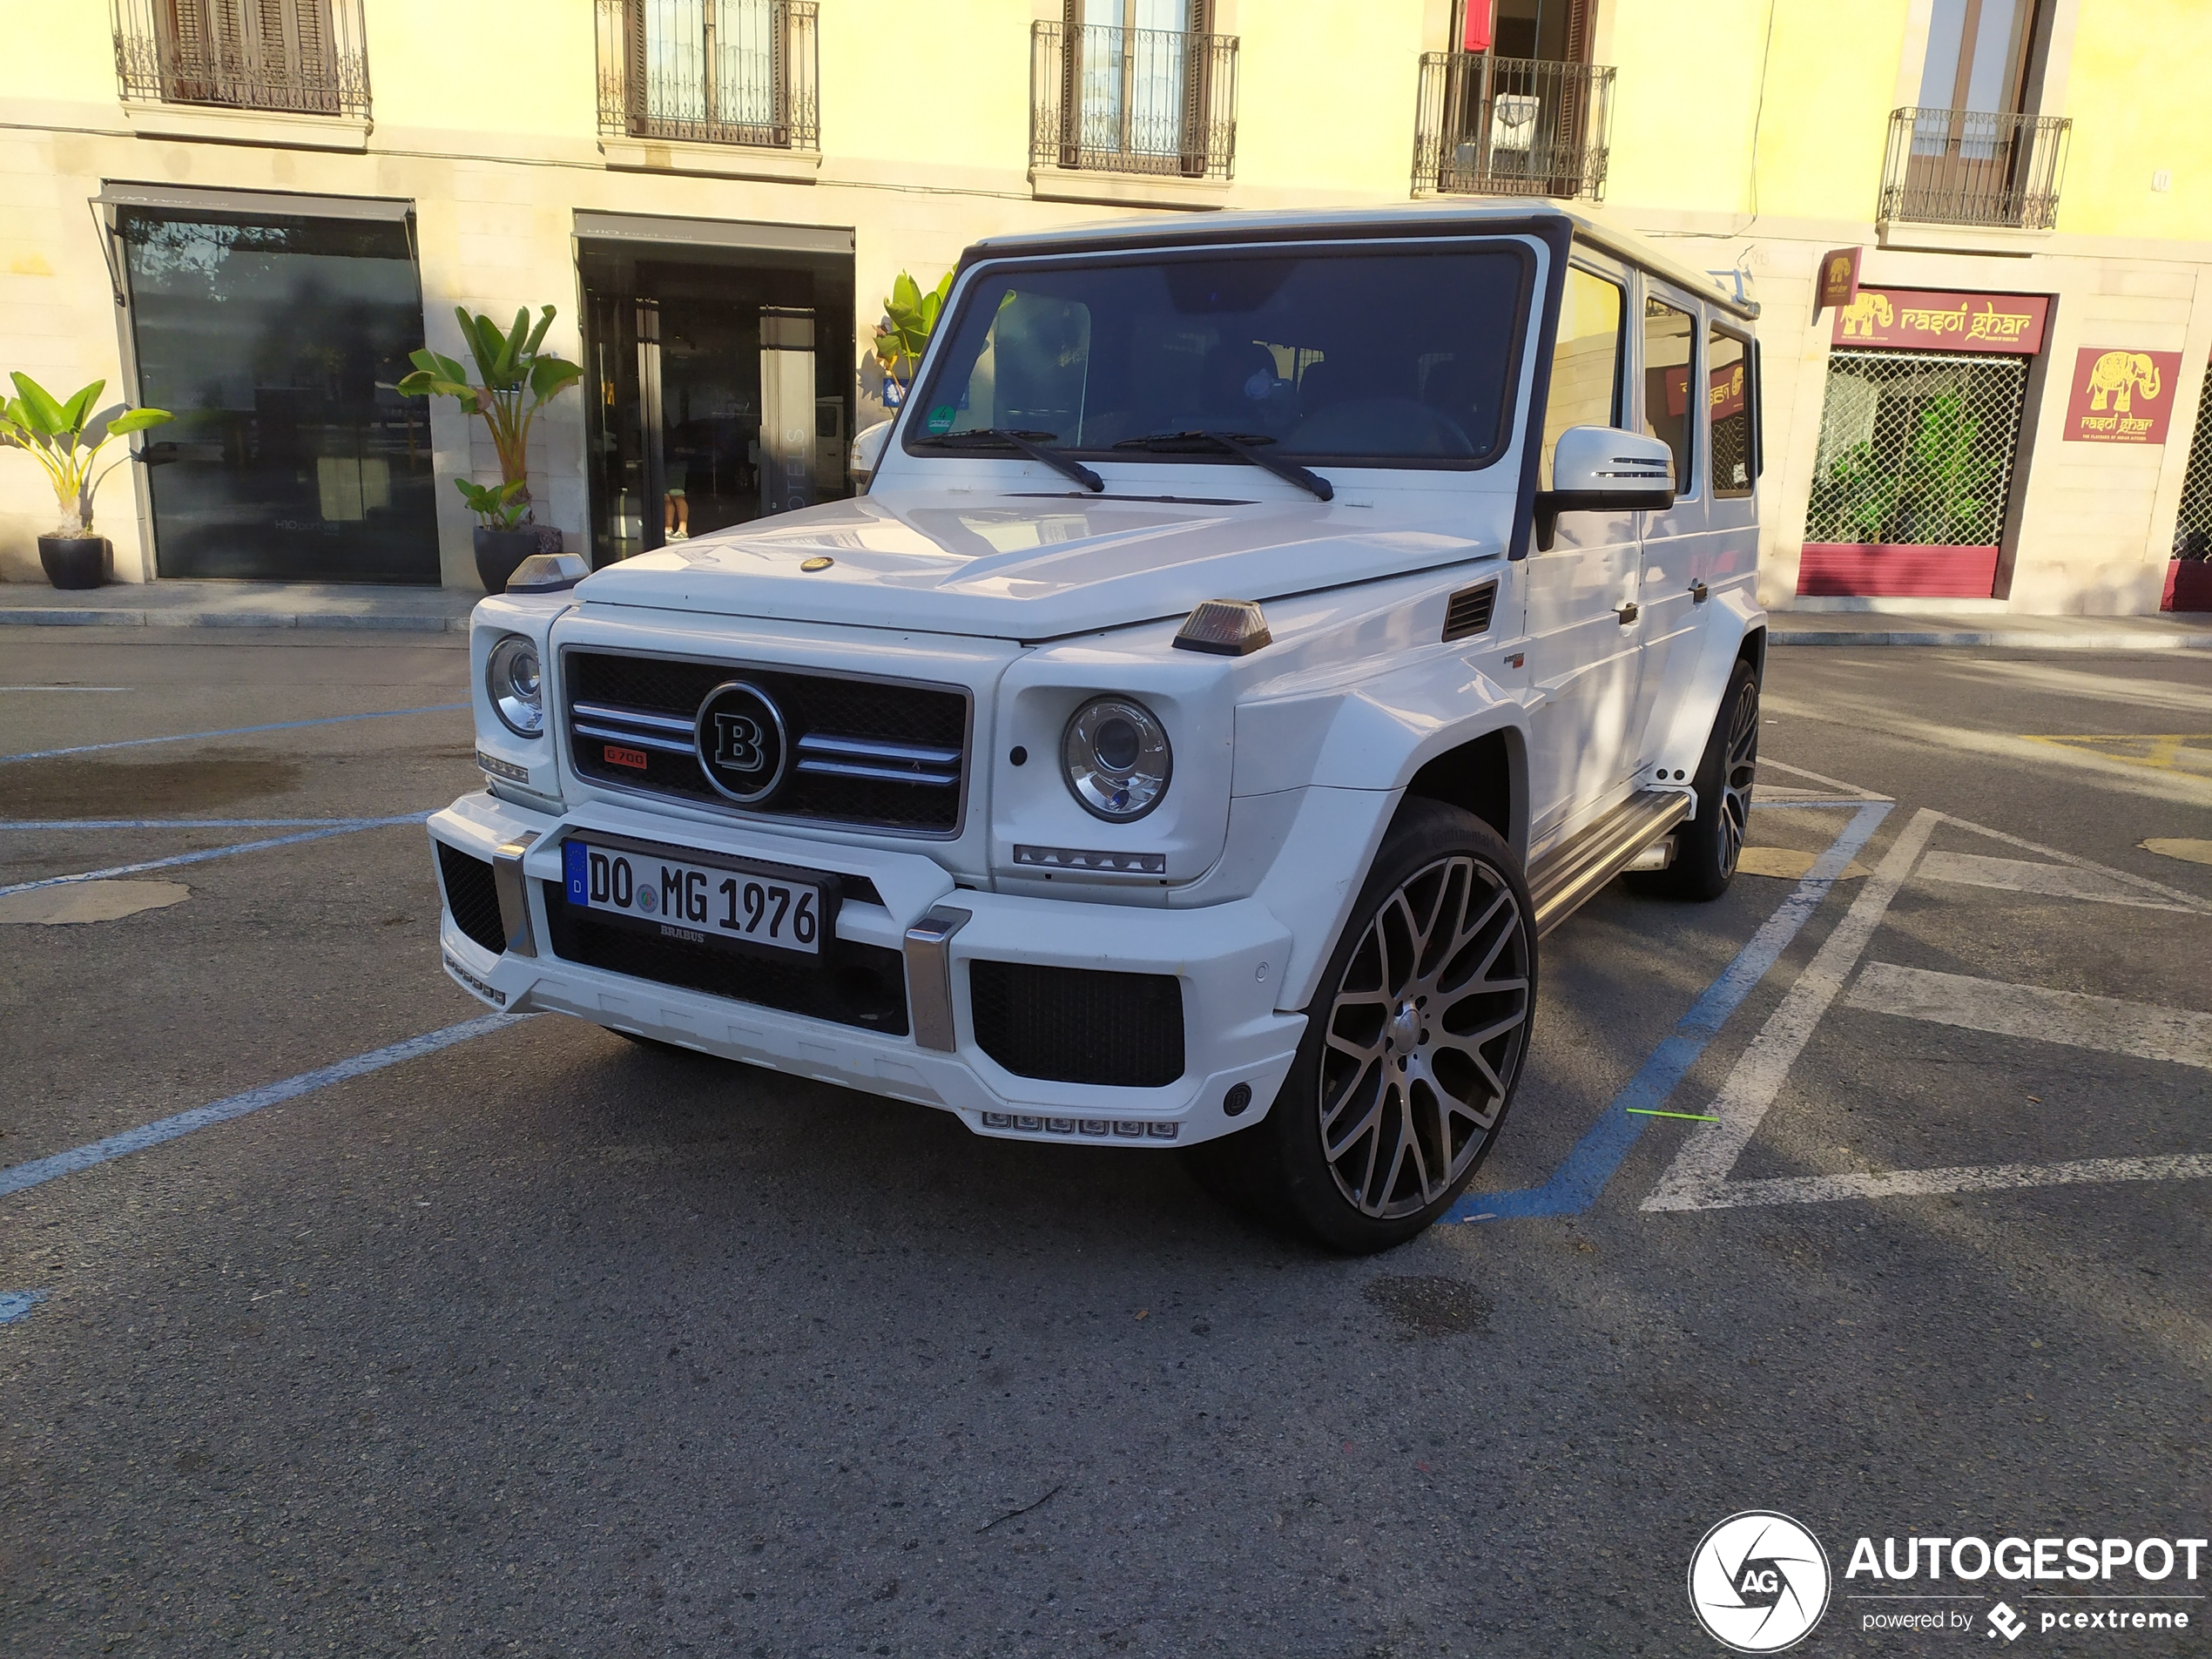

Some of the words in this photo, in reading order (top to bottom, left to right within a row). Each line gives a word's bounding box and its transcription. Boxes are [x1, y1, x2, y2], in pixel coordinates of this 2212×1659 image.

[1900, 300, 1968, 335] rasoi
[1964, 300, 2033, 341] ghar
[938, 406, 947, 420] 4
[2080, 412, 2118, 432] rasoi
[2115, 411, 2155, 435] ghar
[786, 428, 806, 510] OTELS
[714, 712, 765, 772] B
[607, 749, 616, 759] G
[618, 751, 644, 765] 700
[573, 879, 582, 894] D
[589, 852, 633, 908] DO
[661, 865, 707, 923] MG
[718, 877, 816, 944] 1976
[660, 924, 705, 944] BRABUS
